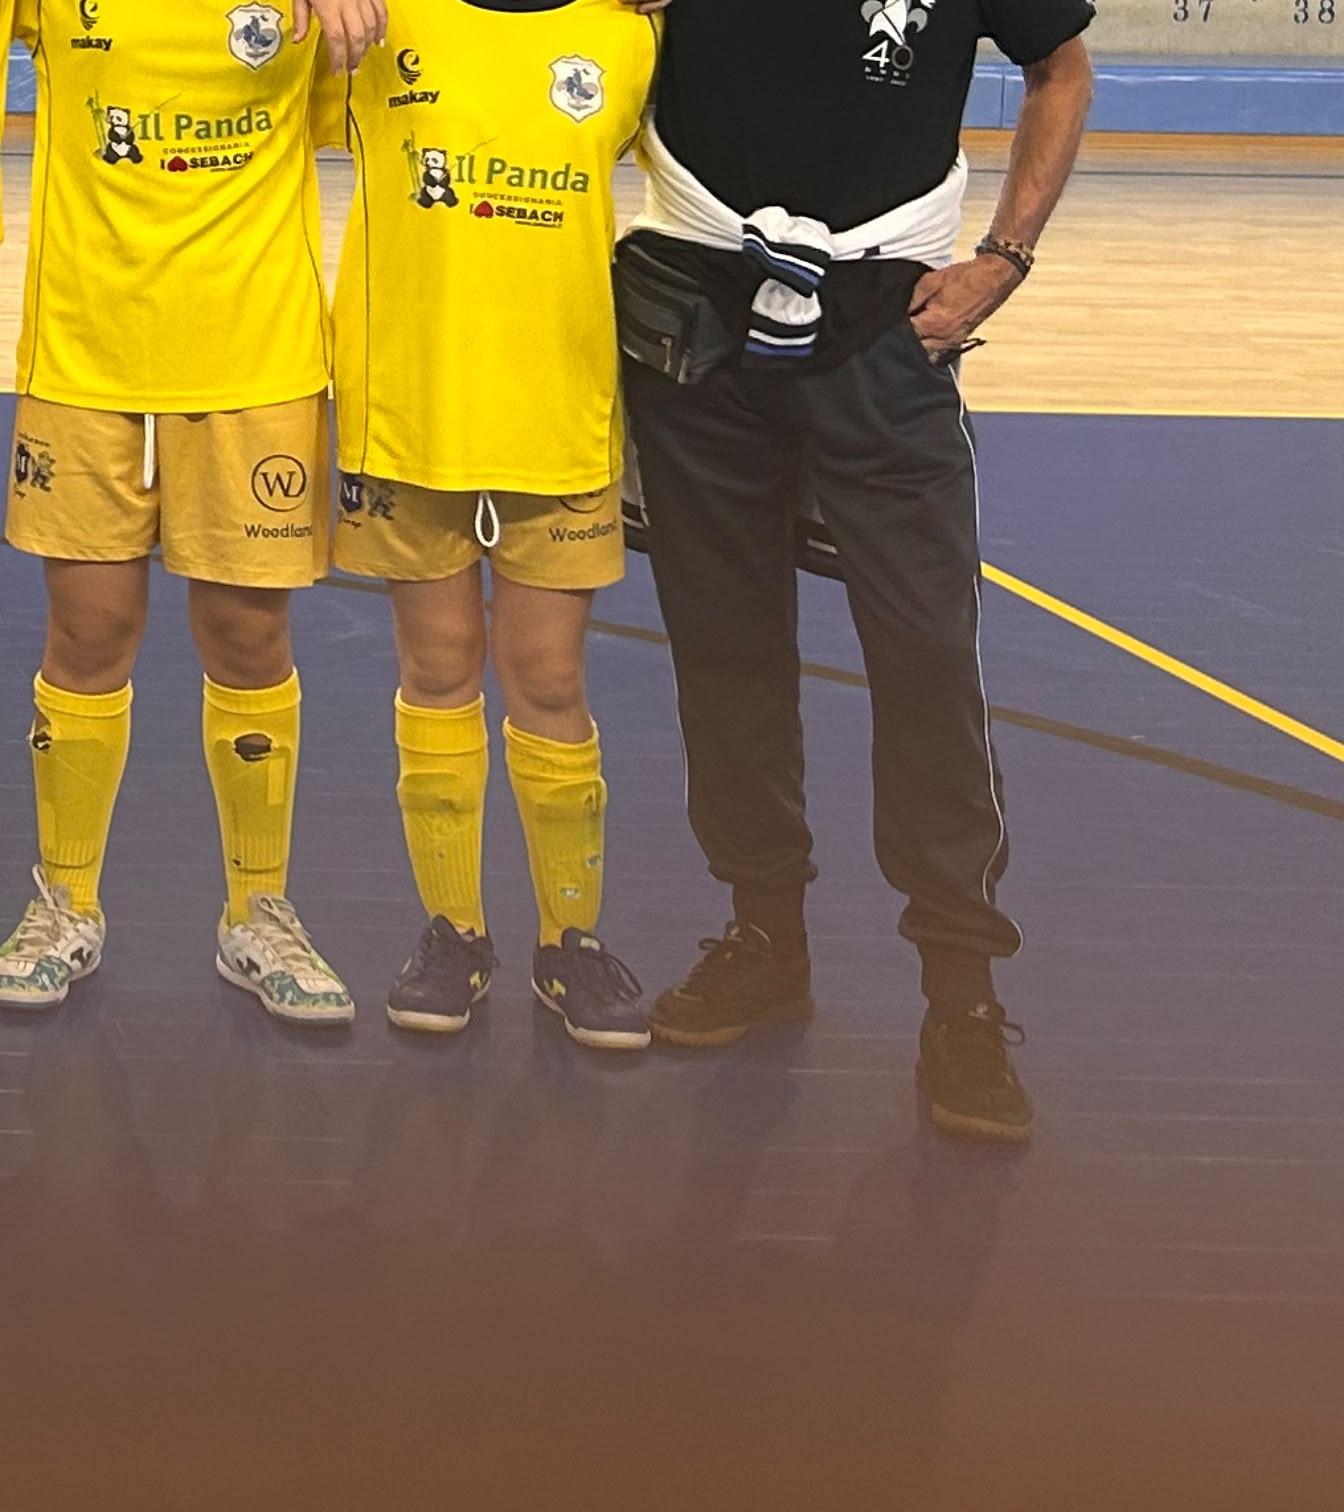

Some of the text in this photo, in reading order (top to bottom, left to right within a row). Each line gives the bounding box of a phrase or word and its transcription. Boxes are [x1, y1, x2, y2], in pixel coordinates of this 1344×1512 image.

[71, 35, 112, 51] makay
[388, 90, 440, 108] makay
[138, 107, 273, 141] Il Panda
[189, 152, 255, 169] SEBACH
[454, 155, 590, 194] Il Panda
[495, 204, 565, 223] SEBACH
[244, 523, 313, 538] Woodlan
